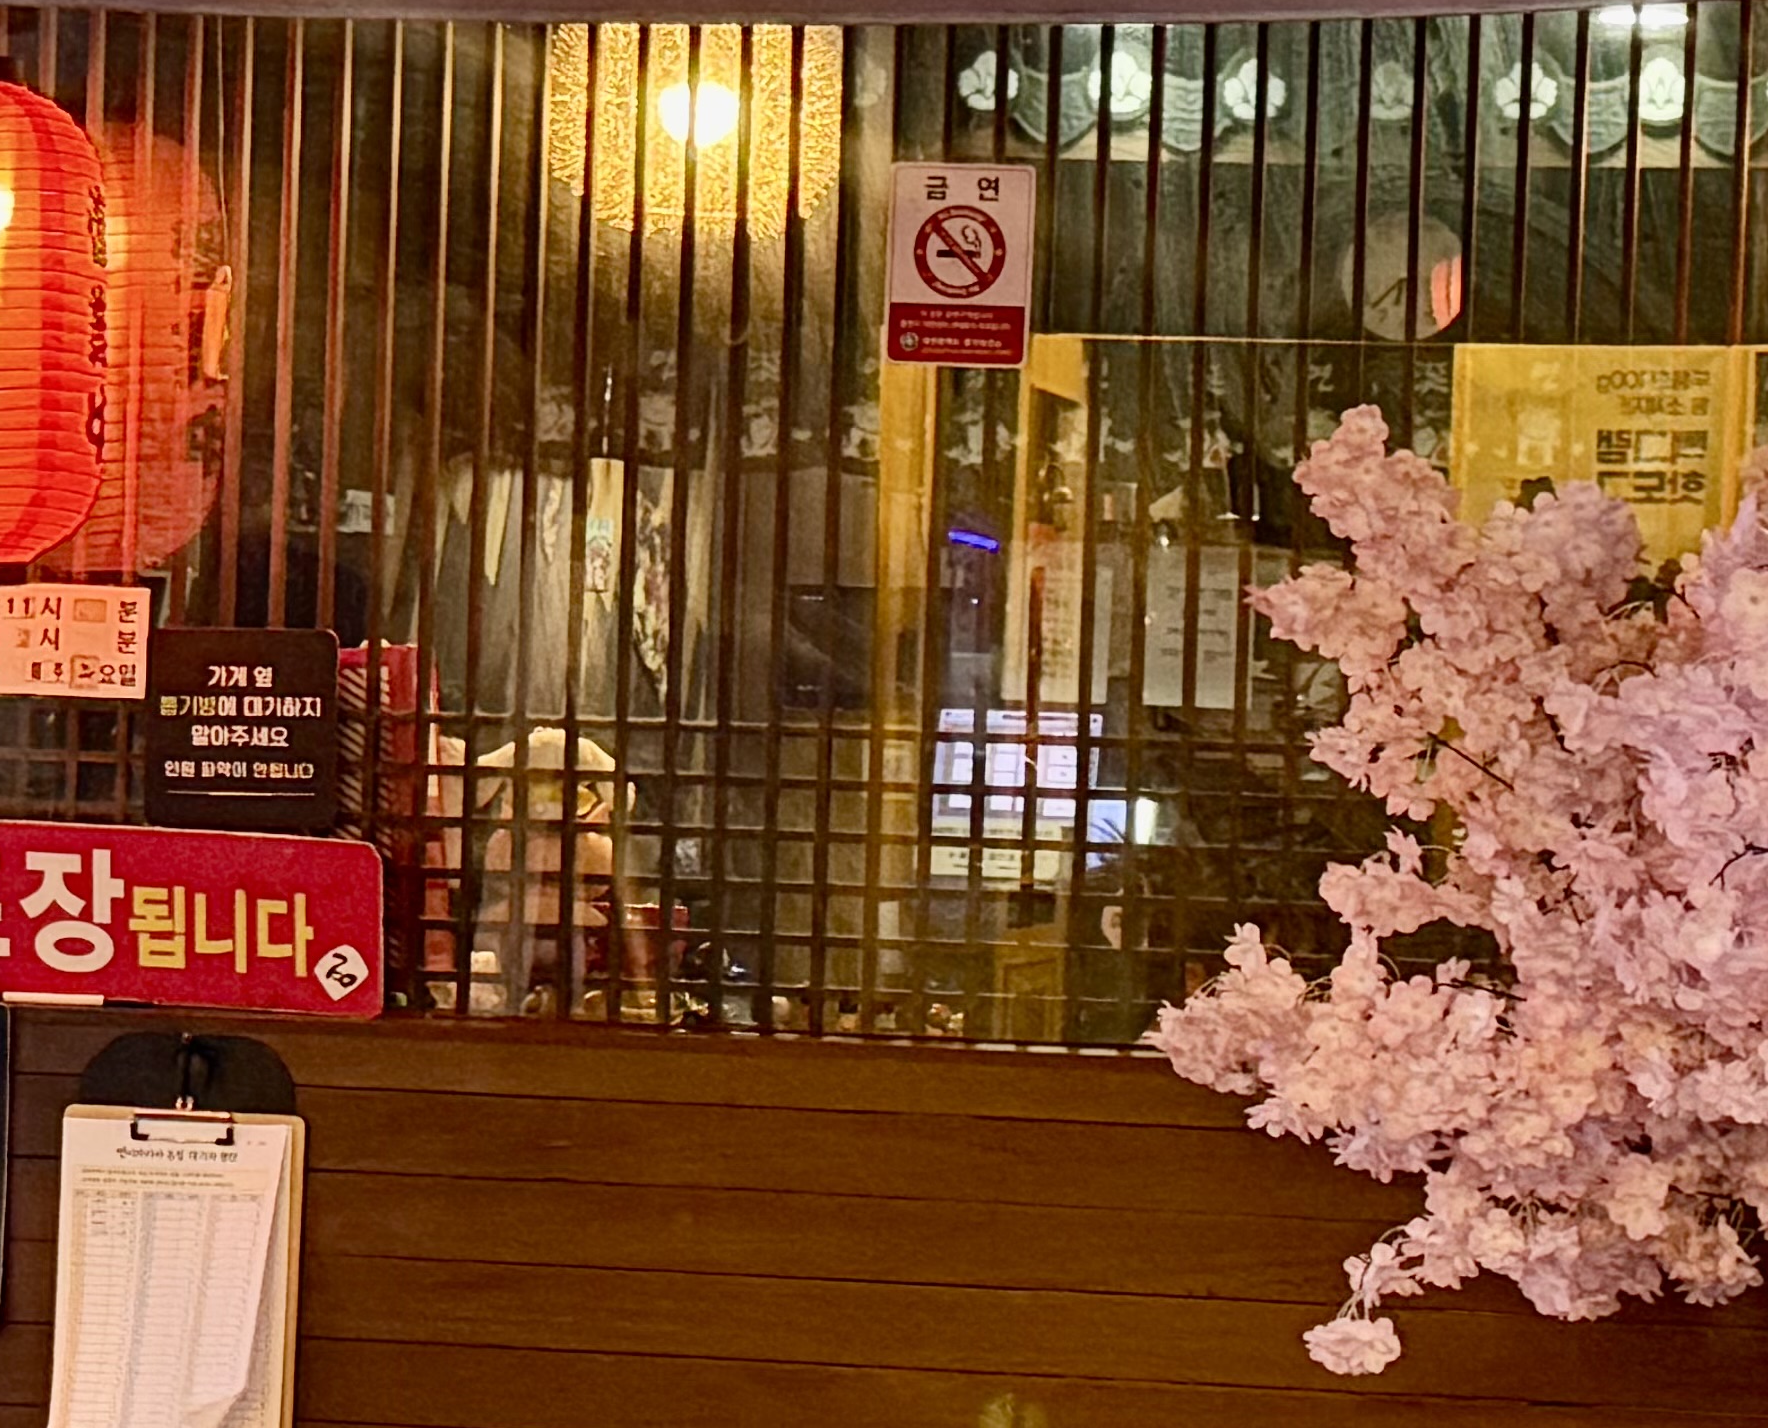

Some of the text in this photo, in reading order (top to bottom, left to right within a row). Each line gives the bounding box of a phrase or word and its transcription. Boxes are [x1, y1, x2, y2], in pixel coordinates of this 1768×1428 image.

[208, 665, 273, 688] 가게 옆
[243, 697, 322, 717] 대기하지
[191, 725, 289, 747] 말아주세요
